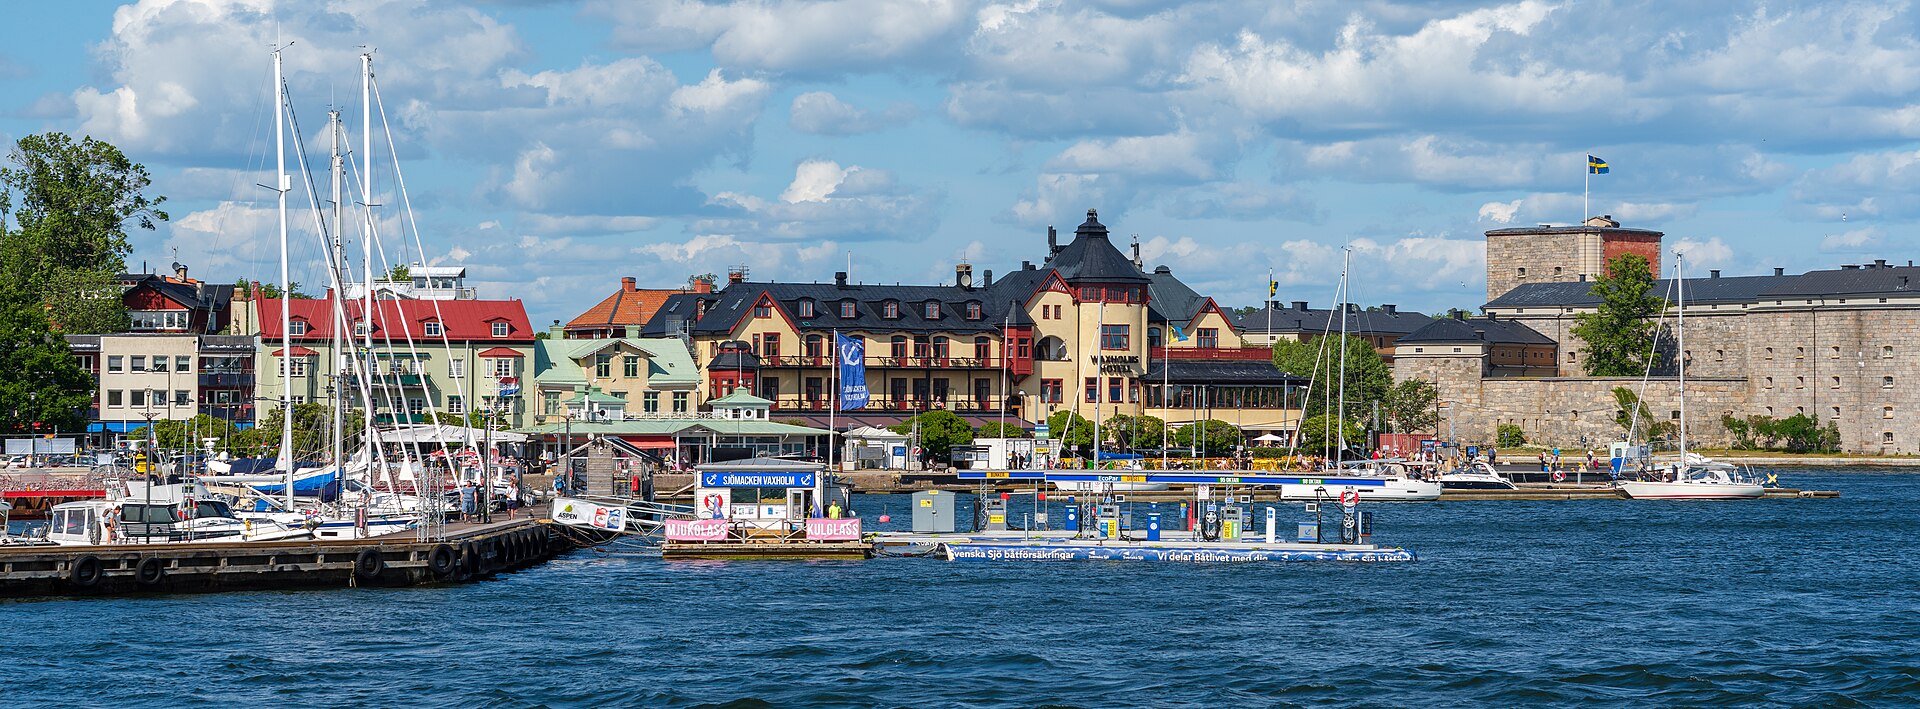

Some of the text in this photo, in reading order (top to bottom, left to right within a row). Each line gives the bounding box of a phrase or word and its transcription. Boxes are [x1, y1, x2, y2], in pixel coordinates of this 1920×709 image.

[723, 474, 795, 485] SJÖMACKEN VAXHOLM
[558, 512, 578, 520] ASPEN
[667, 523, 727, 536] MJUKGLASS
[807, 523, 858, 536] KULGLASS
[988, 550, 1002, 561] Sjö
[1004, 550, 1075, 560] båtförsäkringar
[1157, 551, 1167, 561] Vi
[1169, 551, 1192, 561] delar
[1195, 551, 1230, 562] Båtlivet
